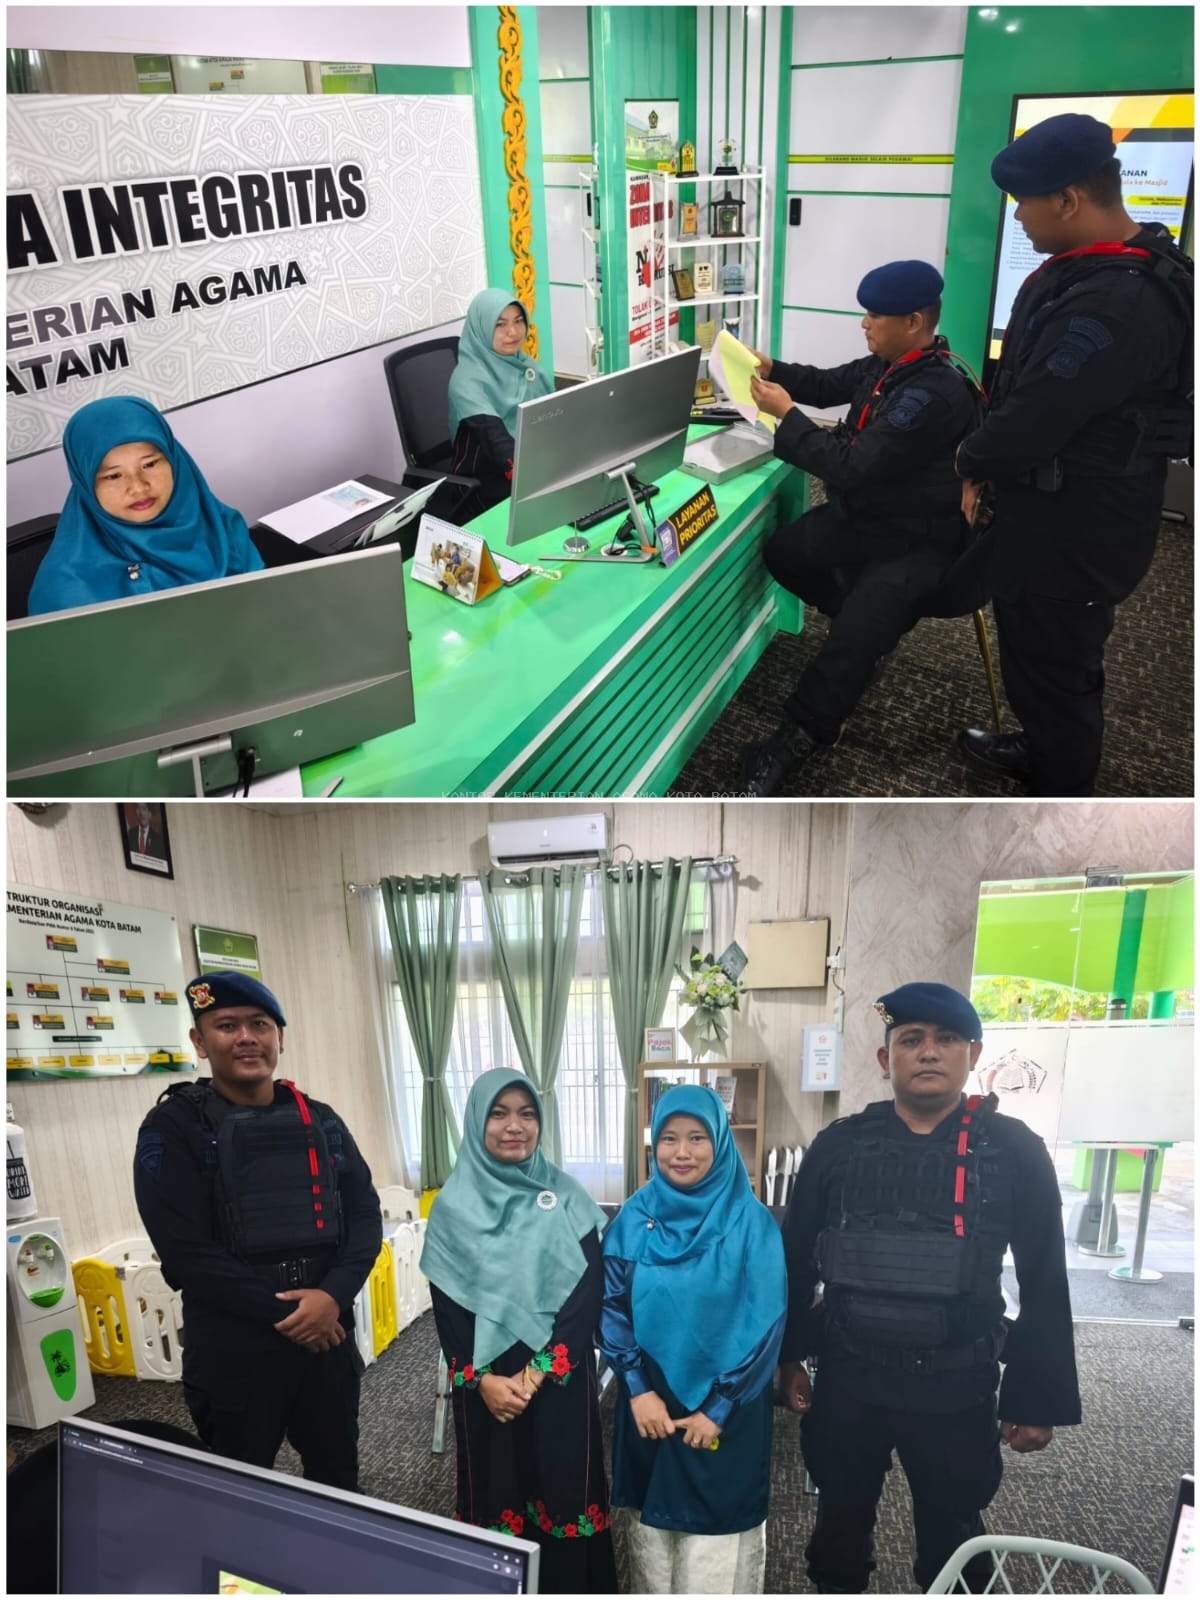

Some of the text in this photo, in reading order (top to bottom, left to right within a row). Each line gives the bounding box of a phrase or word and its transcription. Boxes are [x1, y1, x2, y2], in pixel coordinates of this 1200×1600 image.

[6, 164, 367, 269] A INTEGRITAS
[6, 261, 307, 350] ERIAN AGAMA
[675, 491, 710, 528] LAYANAN
[680, 504, 717, 545] PRIORITAS
[51, 900, 103, 916] ORGANISASI
[64, 913, 94, 926] AGAMA
[96, 918, 116, 930] KOTA
[117, 922, 142, 933] BATAM
